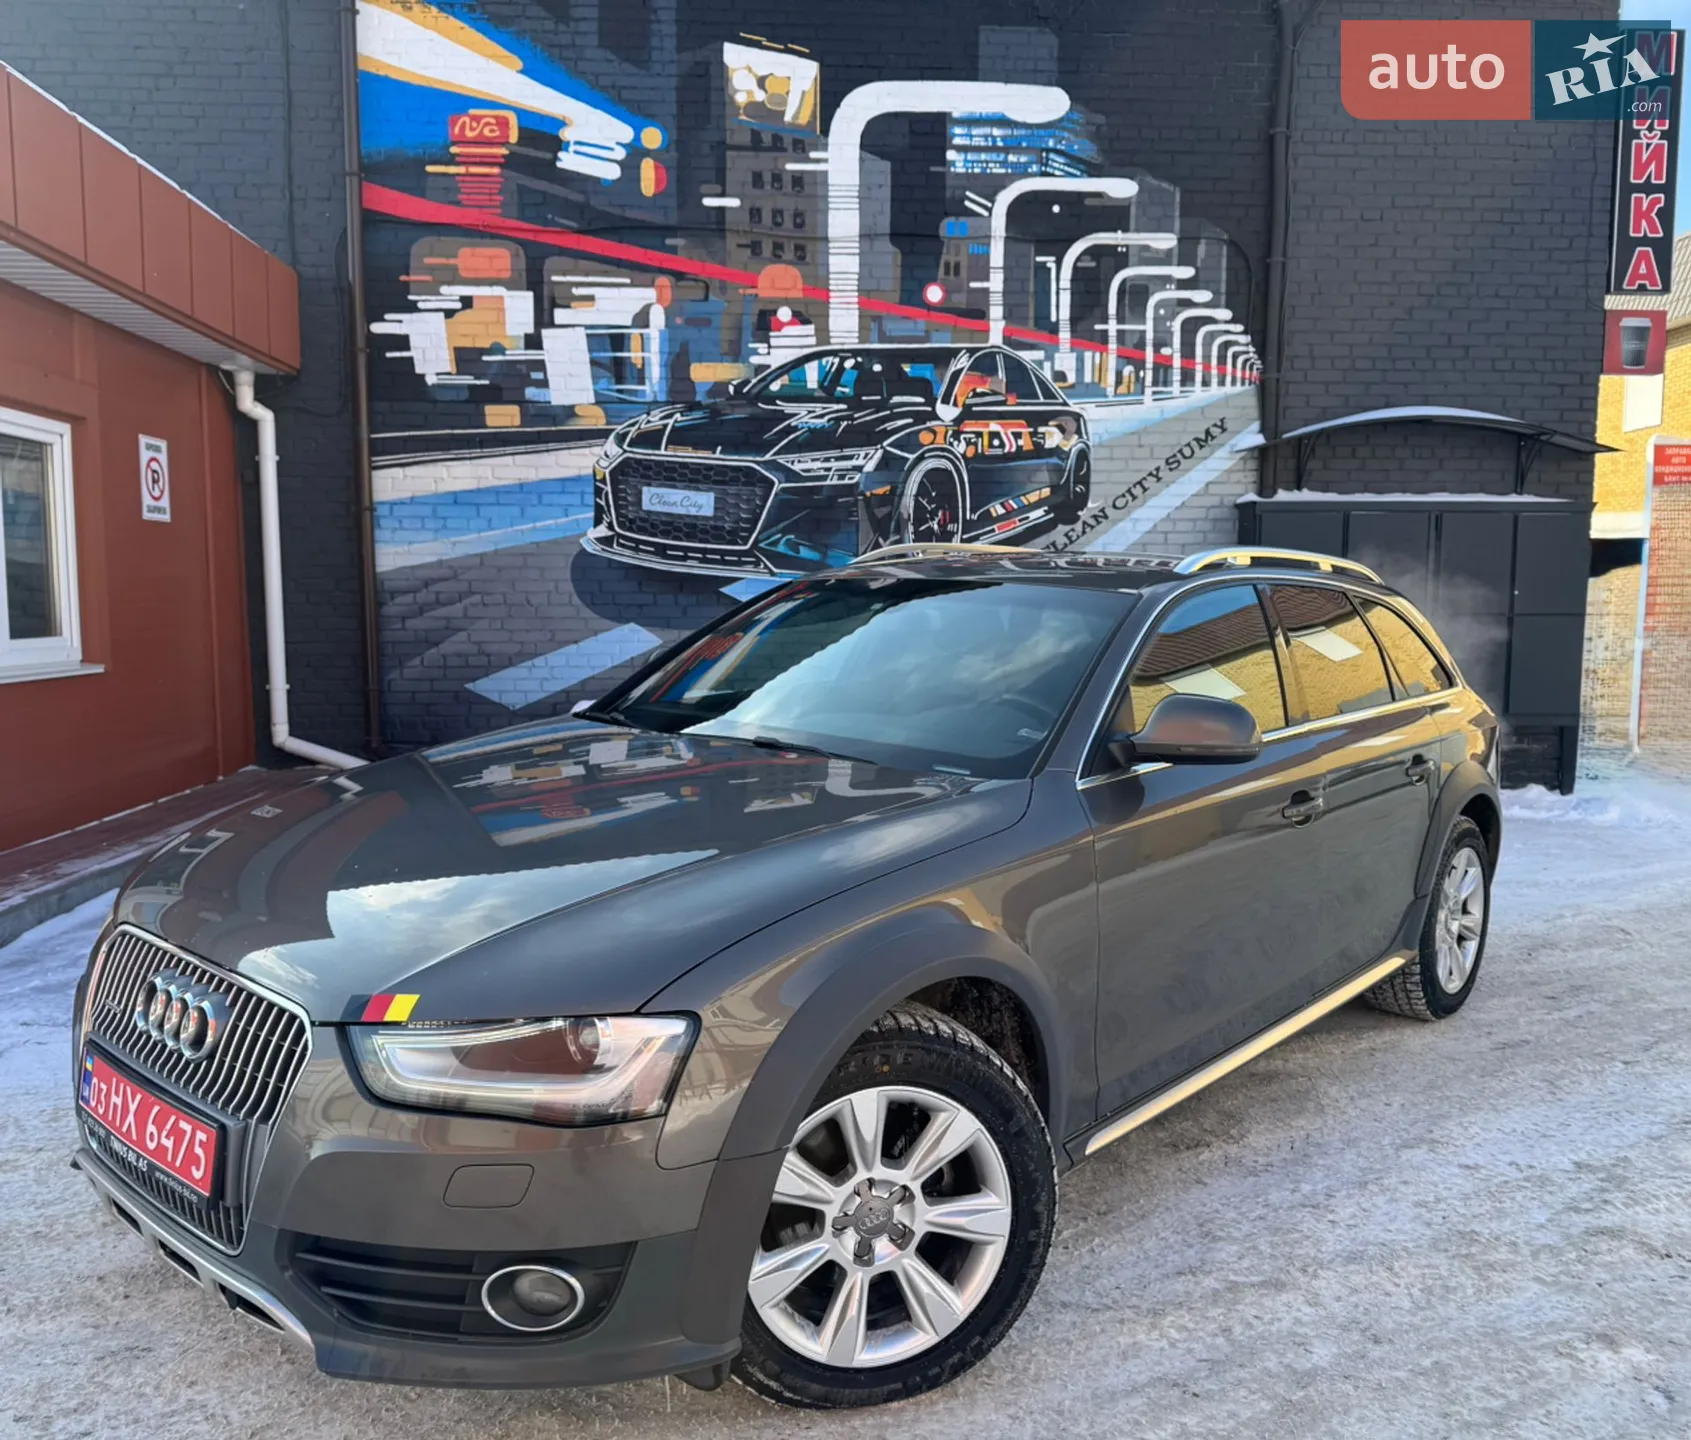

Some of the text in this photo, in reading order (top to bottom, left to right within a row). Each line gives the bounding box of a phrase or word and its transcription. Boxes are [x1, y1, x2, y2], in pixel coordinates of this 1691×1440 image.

[1112, 467, 1163, 511] CITY
[1165, 416, 1229, 472] SUMY
[145, 1105, 208, 1180] 6475
